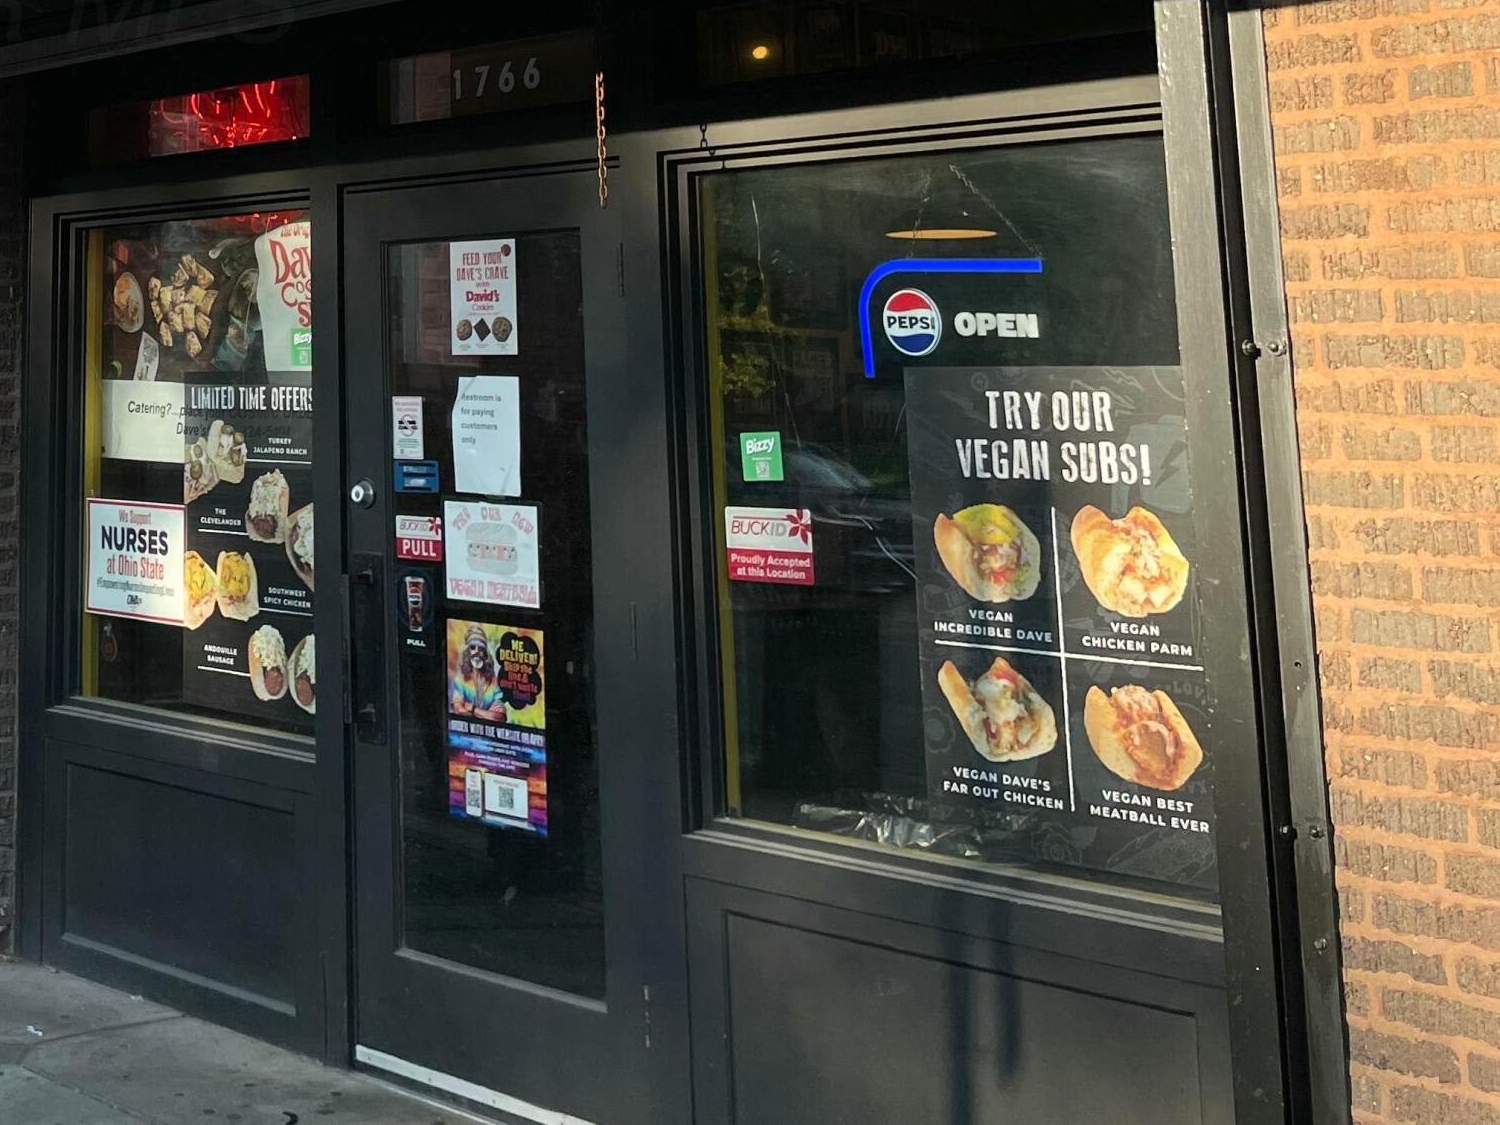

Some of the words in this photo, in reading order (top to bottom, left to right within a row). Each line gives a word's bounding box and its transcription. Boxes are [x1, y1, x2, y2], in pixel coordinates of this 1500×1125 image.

[452, 57, 541, 101] 1766
[463, 252, 479, 266] FEED
[483, 250, 502, 264] YOUR
[456, 267, 483, 281] DAVE'S
[485, 266, 509, 279] CRAVE
[466, 289, 500, 303] David's
[886, 313, 937, 332] PEPSI
[954, 311, 1040, 339] OPEN
[191, 386, 235, 411] LIMITED
[239, 387, 267, 411] TIME
[461, 407, 470, 416] for
[472, 408, 494, 418] paying
[985, 390, 1041, 431] TRY
[1051, 390, 1114, 432] OUR
[461, 422, 498, 431] customers
[268, 437, 292, 446] TURKEY
[461, 436, 476, 445] only
[745, 437, 775, 455] Bizzy
[286, 448, 308, 456] RANCH
[955, 438, 1050, 481] VEGAN
[1060, 441, 1153, 486] SUBS!
[215, 507, 227, 516] THE
[200, 516, 241, 526] CLEVELANDER
[731, 520, 787, 537] BUCKID
[101, 525, 169, 556] NURSES
[402, 538, 437, 557] PULL
[107, 555, 116, 574] at
[118, 554, 138, 576] Ohio
[140, 557, 164, 580] State
[731, 553, 765, 566] Proudly
[767, 555, 810, 567] Accepted
[737, 567, 746, 575] at
[748, 567, 765, 577] this
[766, 569, 805, 580] Location
[268, 587, 306, 598] SOUTHWEST
[263, 597, 281, 606] SPICY
[283, 599, 311, 608] CHICKEN
[968, 609, 1013, 622] VEGAN
[934, 622, 1012, 638] INCREDIBLE
[1016, 630, 1052, 642] DAVE
[1110, 622, 1160, 636] VEGAN
[203, 644, 237, 656] ANDOUILLE
[407, 638, 426, 648] PULL
[1082, 636, 1145, 652] CHICKEN
[1151, 641, 1193, 656] PARM
[207, 655, 234, 665] SAUSAGE
[953, 766, 998, 783] VEGAN
[1002, 774, 1051, 792] DAVE'S
[943, 780, 968, 794] FAR
[972, 785, 999, 800] OUT
[1003, 791, 1063, 810] CHICKEN
[1102, 790, 1151, 807] VEGAN
[1156, 798, 1194, 813] BEST
[1090, 804, 1166, 826] MEATBALL
[1171, 817, 1210, 833] EVER
